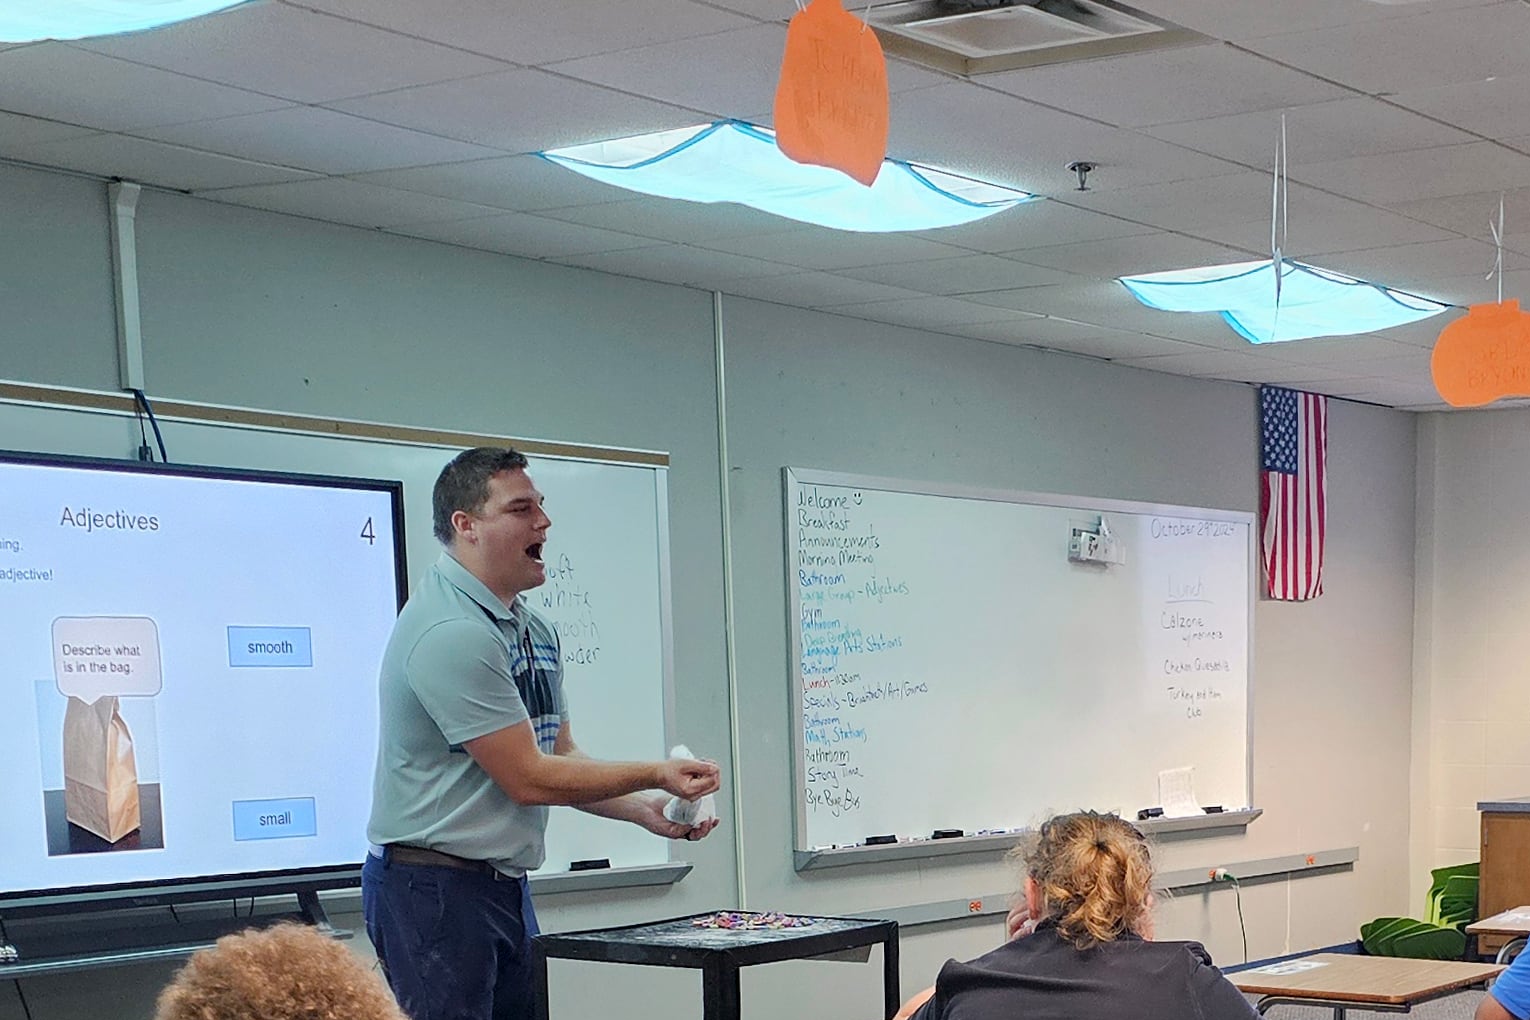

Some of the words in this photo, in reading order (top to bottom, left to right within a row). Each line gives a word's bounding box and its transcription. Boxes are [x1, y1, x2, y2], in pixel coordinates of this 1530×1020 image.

[798, 486, 851, 510] Welcome
[60, 506, 160, 532] Adjectives
[798, 508, 850, 532] Breakfast
[1151, 517, 1195, 539] October
[360, 516, 376, 546] 4
[0, 568, 53, 583] adjective!
[545, 553, 575, 581] oft
[541, 583, 593, 609] white
[62, 643, 111, 657] Describe
[114, 643, 141, 657] what
[248, 639, 293, 655] smooth
[63, 660, 74, 673] is
[76, 660, 87, 673] in
[89, 660, 107, 674] the
[110, 661, 134, 676] bag.
[259, 811, 292, 826] small
